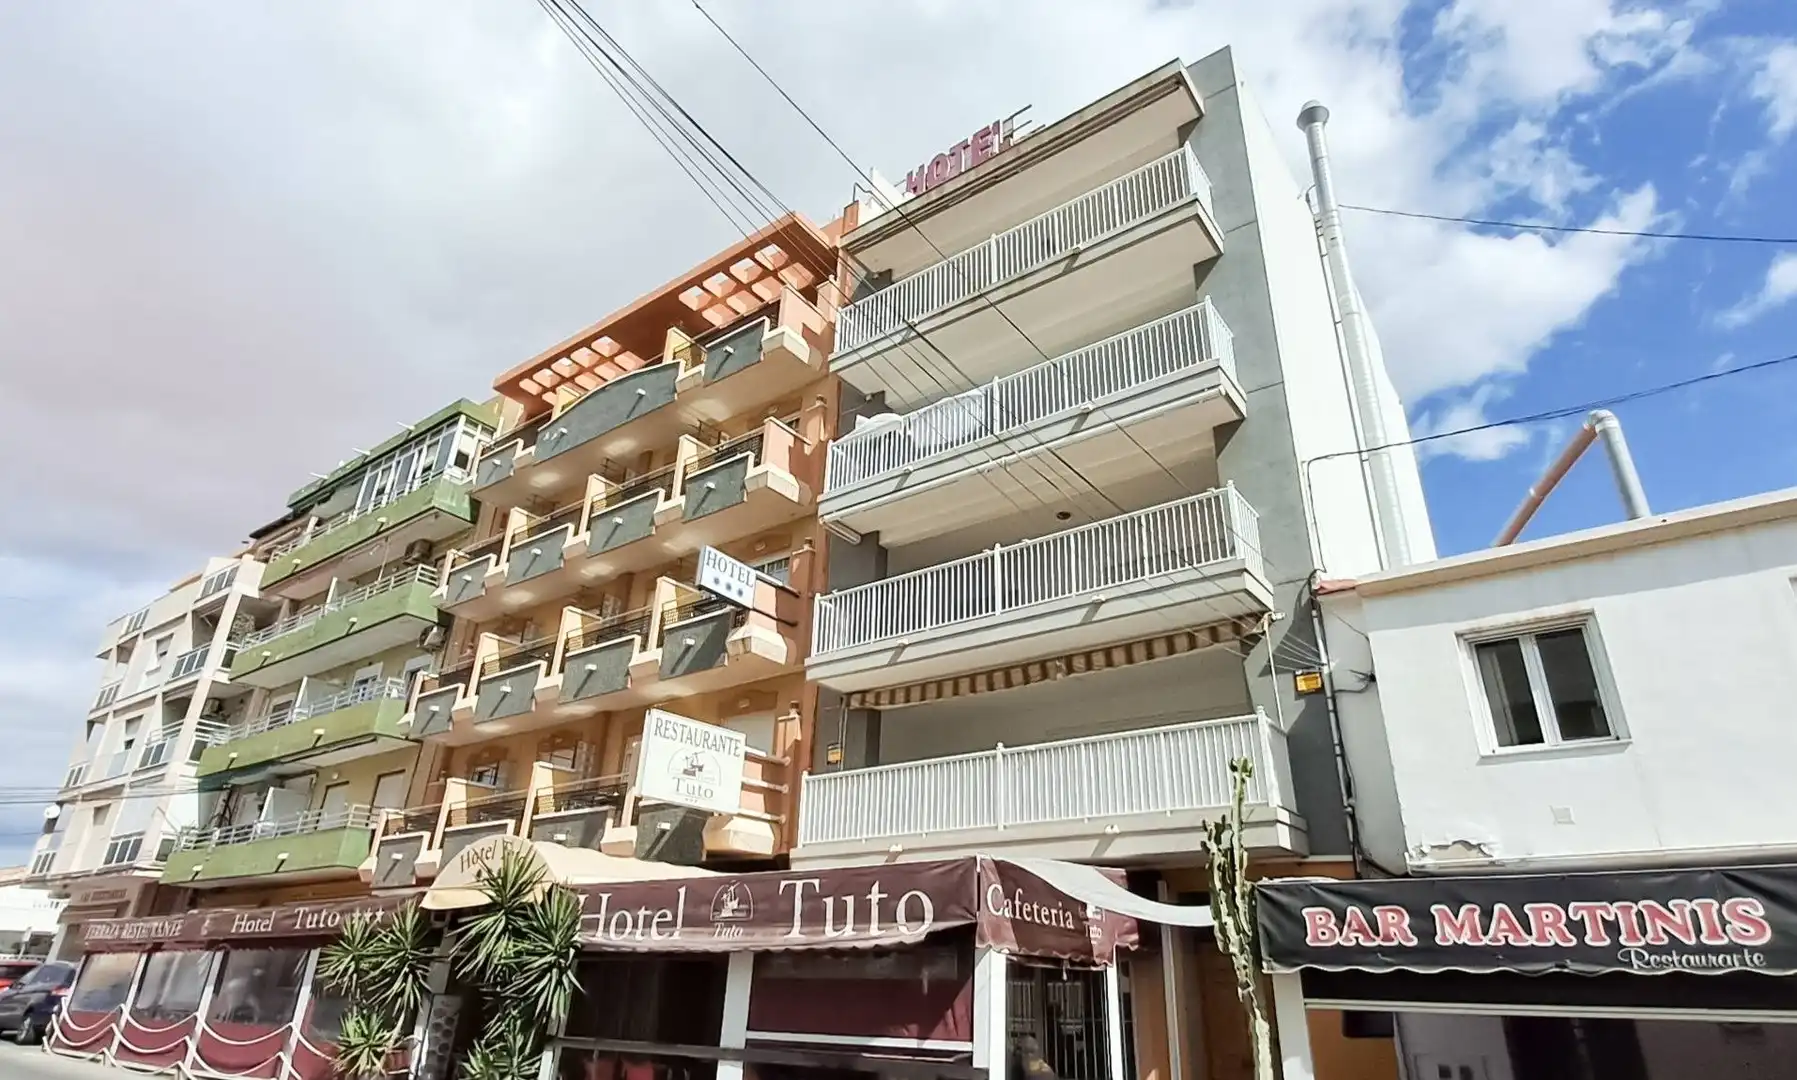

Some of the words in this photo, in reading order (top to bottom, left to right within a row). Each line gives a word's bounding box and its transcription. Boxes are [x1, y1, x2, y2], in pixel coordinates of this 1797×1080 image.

[706, 550, 754, 588] HOTEL
[654, 717, 742, 758] RESTAURANTE
[672, 776, 714, 799] Tuto
[460, 840, 498, 873] Hotel
[231, 911, 276, 934] Hotel
[294, 906, 341, 930] Tuto
[572, 885, 687, 941] Hotel
[779, 878, 934, 938] Tuto
[986, 884, 1075, 930] Cafeteria
[1301, 905, 1419, 947] BAR
[1430, 897, 1773, 947] MARTINIS
[713, 921, 744, 939] Tuto
